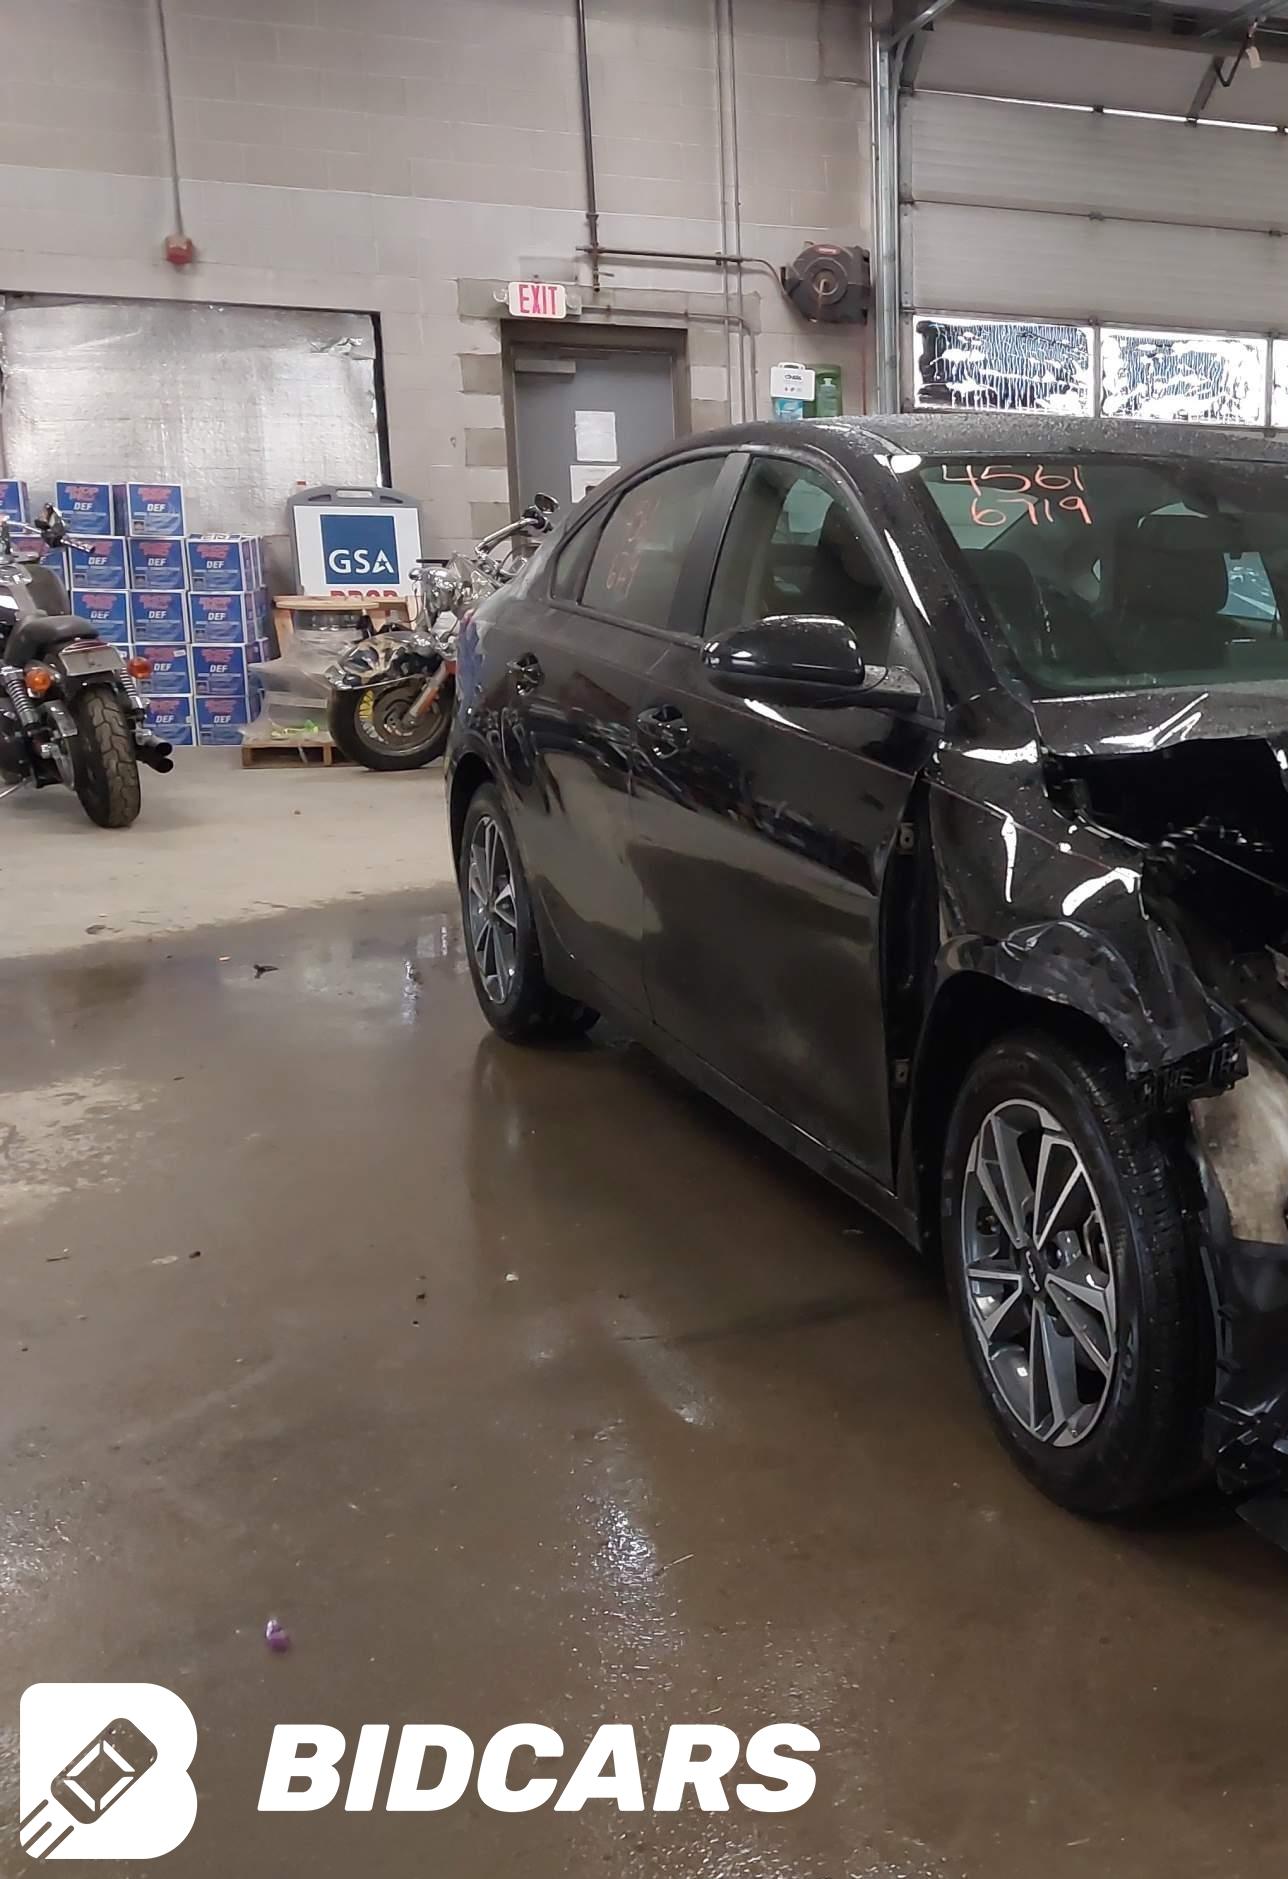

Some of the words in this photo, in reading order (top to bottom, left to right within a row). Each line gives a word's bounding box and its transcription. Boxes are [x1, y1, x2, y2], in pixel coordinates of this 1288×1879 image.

[518, 284, 558, 315] EXIT
[941, 464, 1085, 496] 4561
[73, 502, 93, 511] DEF
[147, 503, 166, 512] DEF
[971, 496, 1093, 526] 6719
[88, 556, 108, 565] DEF
[147, 558, 167, 566] DEF
[206, 560, 225, 569] DEF
[328, 549, 395, 574] GSA
[90, 610, 110, 619] DEF
[148, 610, 168, 619] DEF
[207, 612, 226, 621] DEF
[153, 663, 172, 672] DEF
[209, 664, 228, 673] DEF
[155, 715, 175, 724] DEF
[213, 715, 232, 724] DEF
